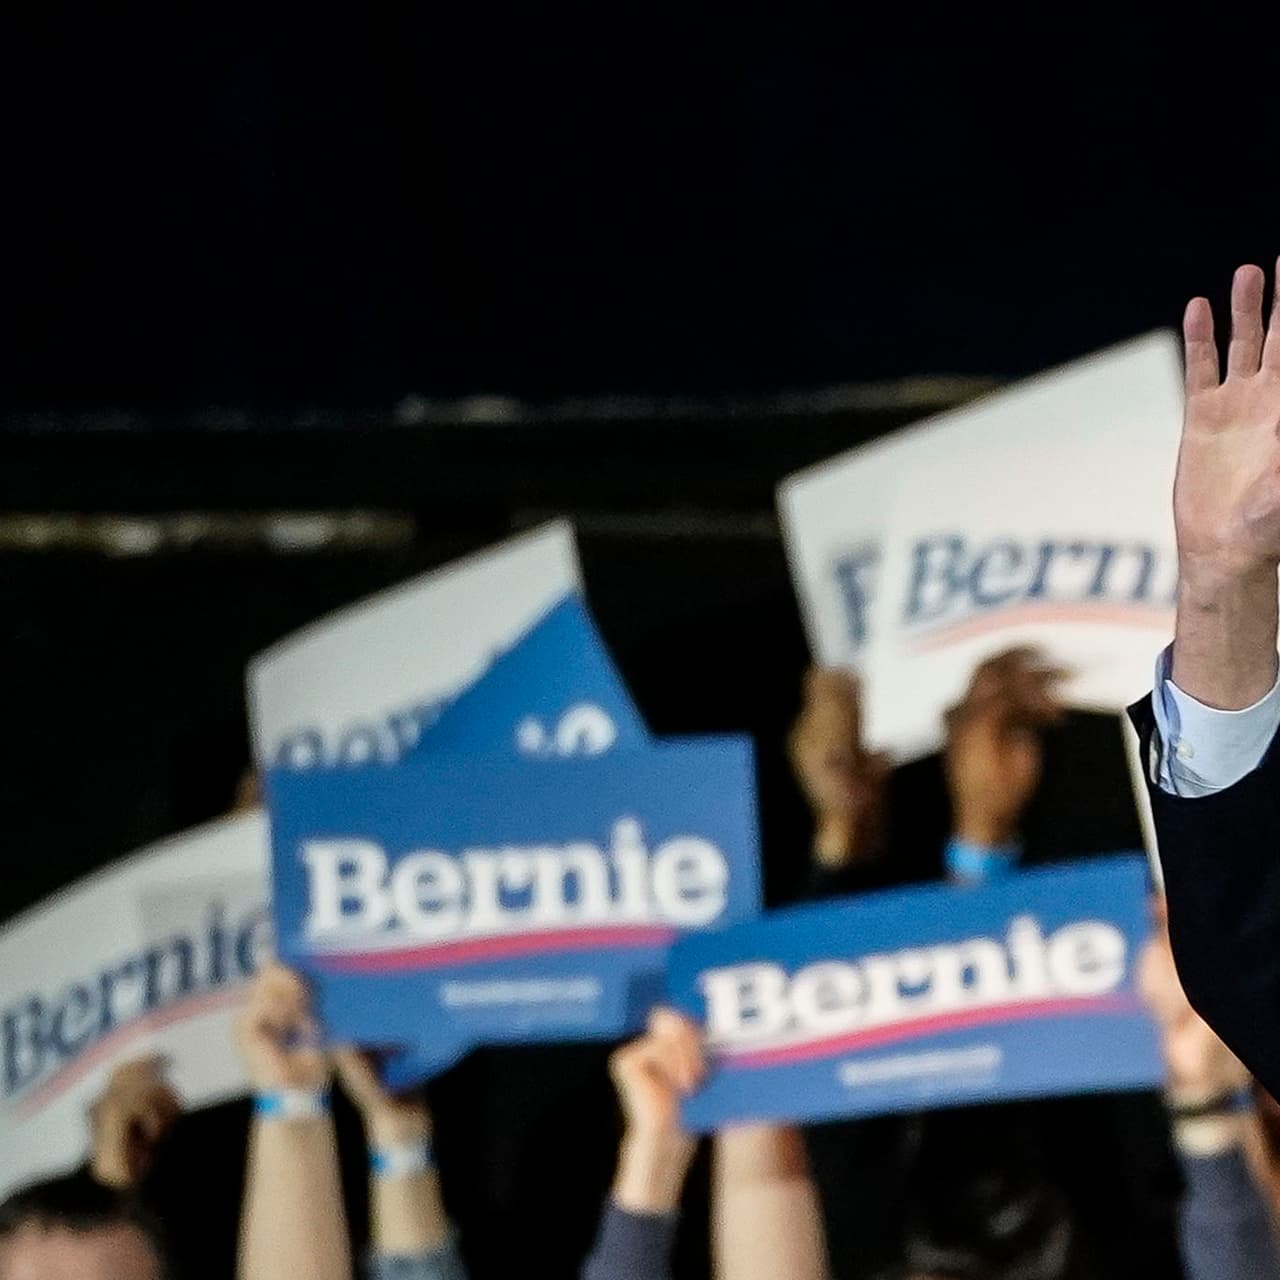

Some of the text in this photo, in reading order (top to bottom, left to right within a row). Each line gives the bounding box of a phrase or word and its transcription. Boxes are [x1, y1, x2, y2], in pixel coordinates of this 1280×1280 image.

[904, 532, 1178, 624] Bern
[300, 816, 730, 940] Bernie
[702, 912, 1128, 1042] Bernie
